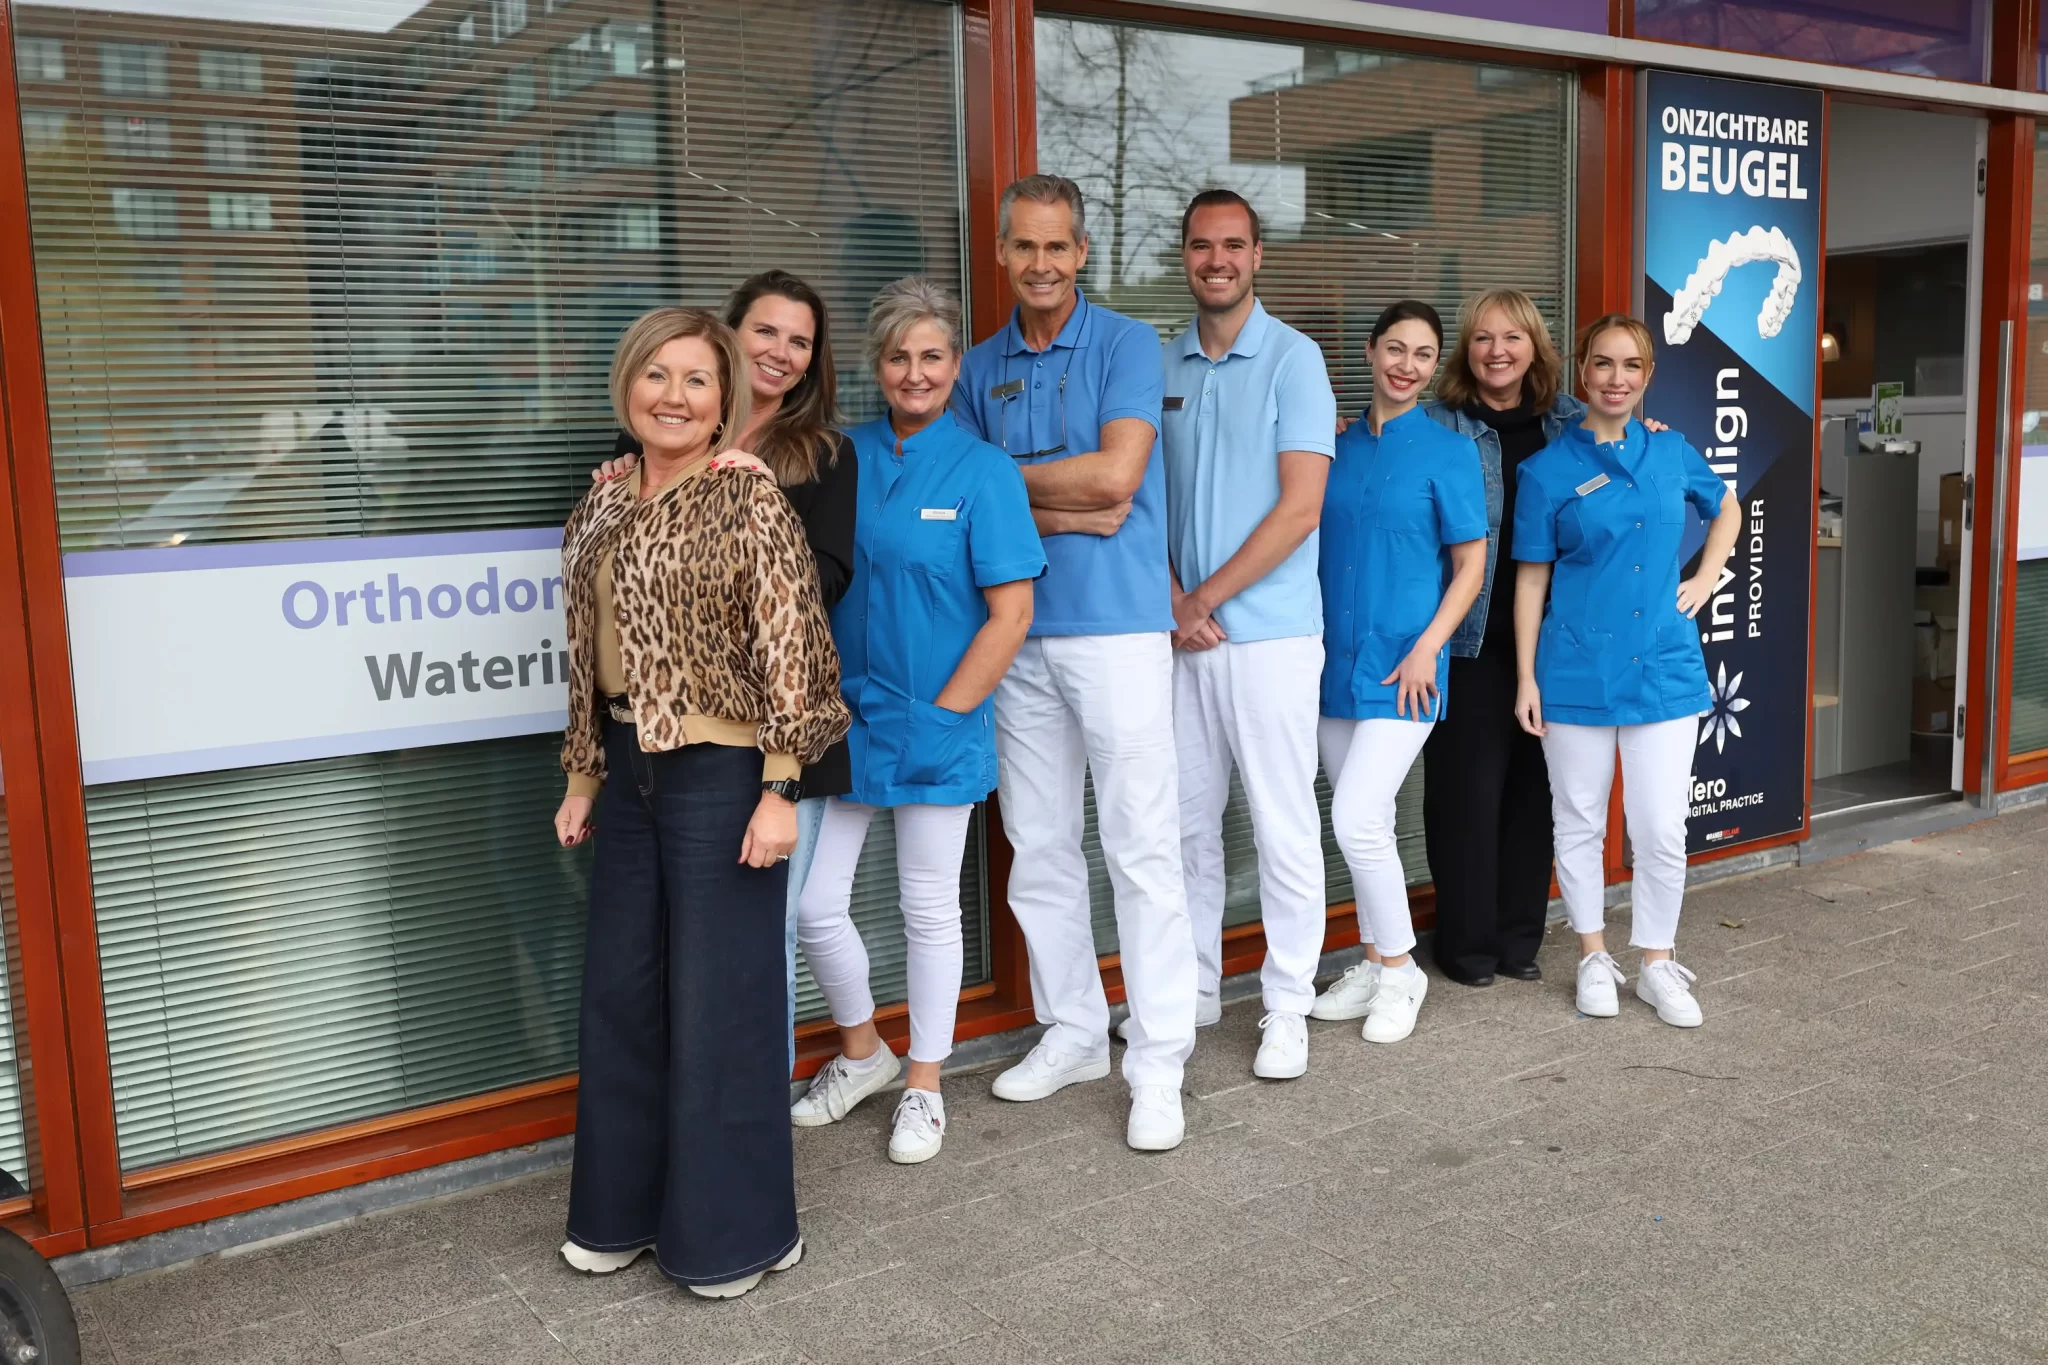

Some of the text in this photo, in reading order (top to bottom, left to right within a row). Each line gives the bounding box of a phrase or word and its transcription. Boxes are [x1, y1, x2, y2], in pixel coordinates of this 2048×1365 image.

[1661, 106, 1809, 146] ONZICHTBARE
[1661, 142, 1808, 200] BEUGEL
[1748, 499, 1764, 638] PROVIDER
[1719, 792, 1764, 812] PRACTICE
